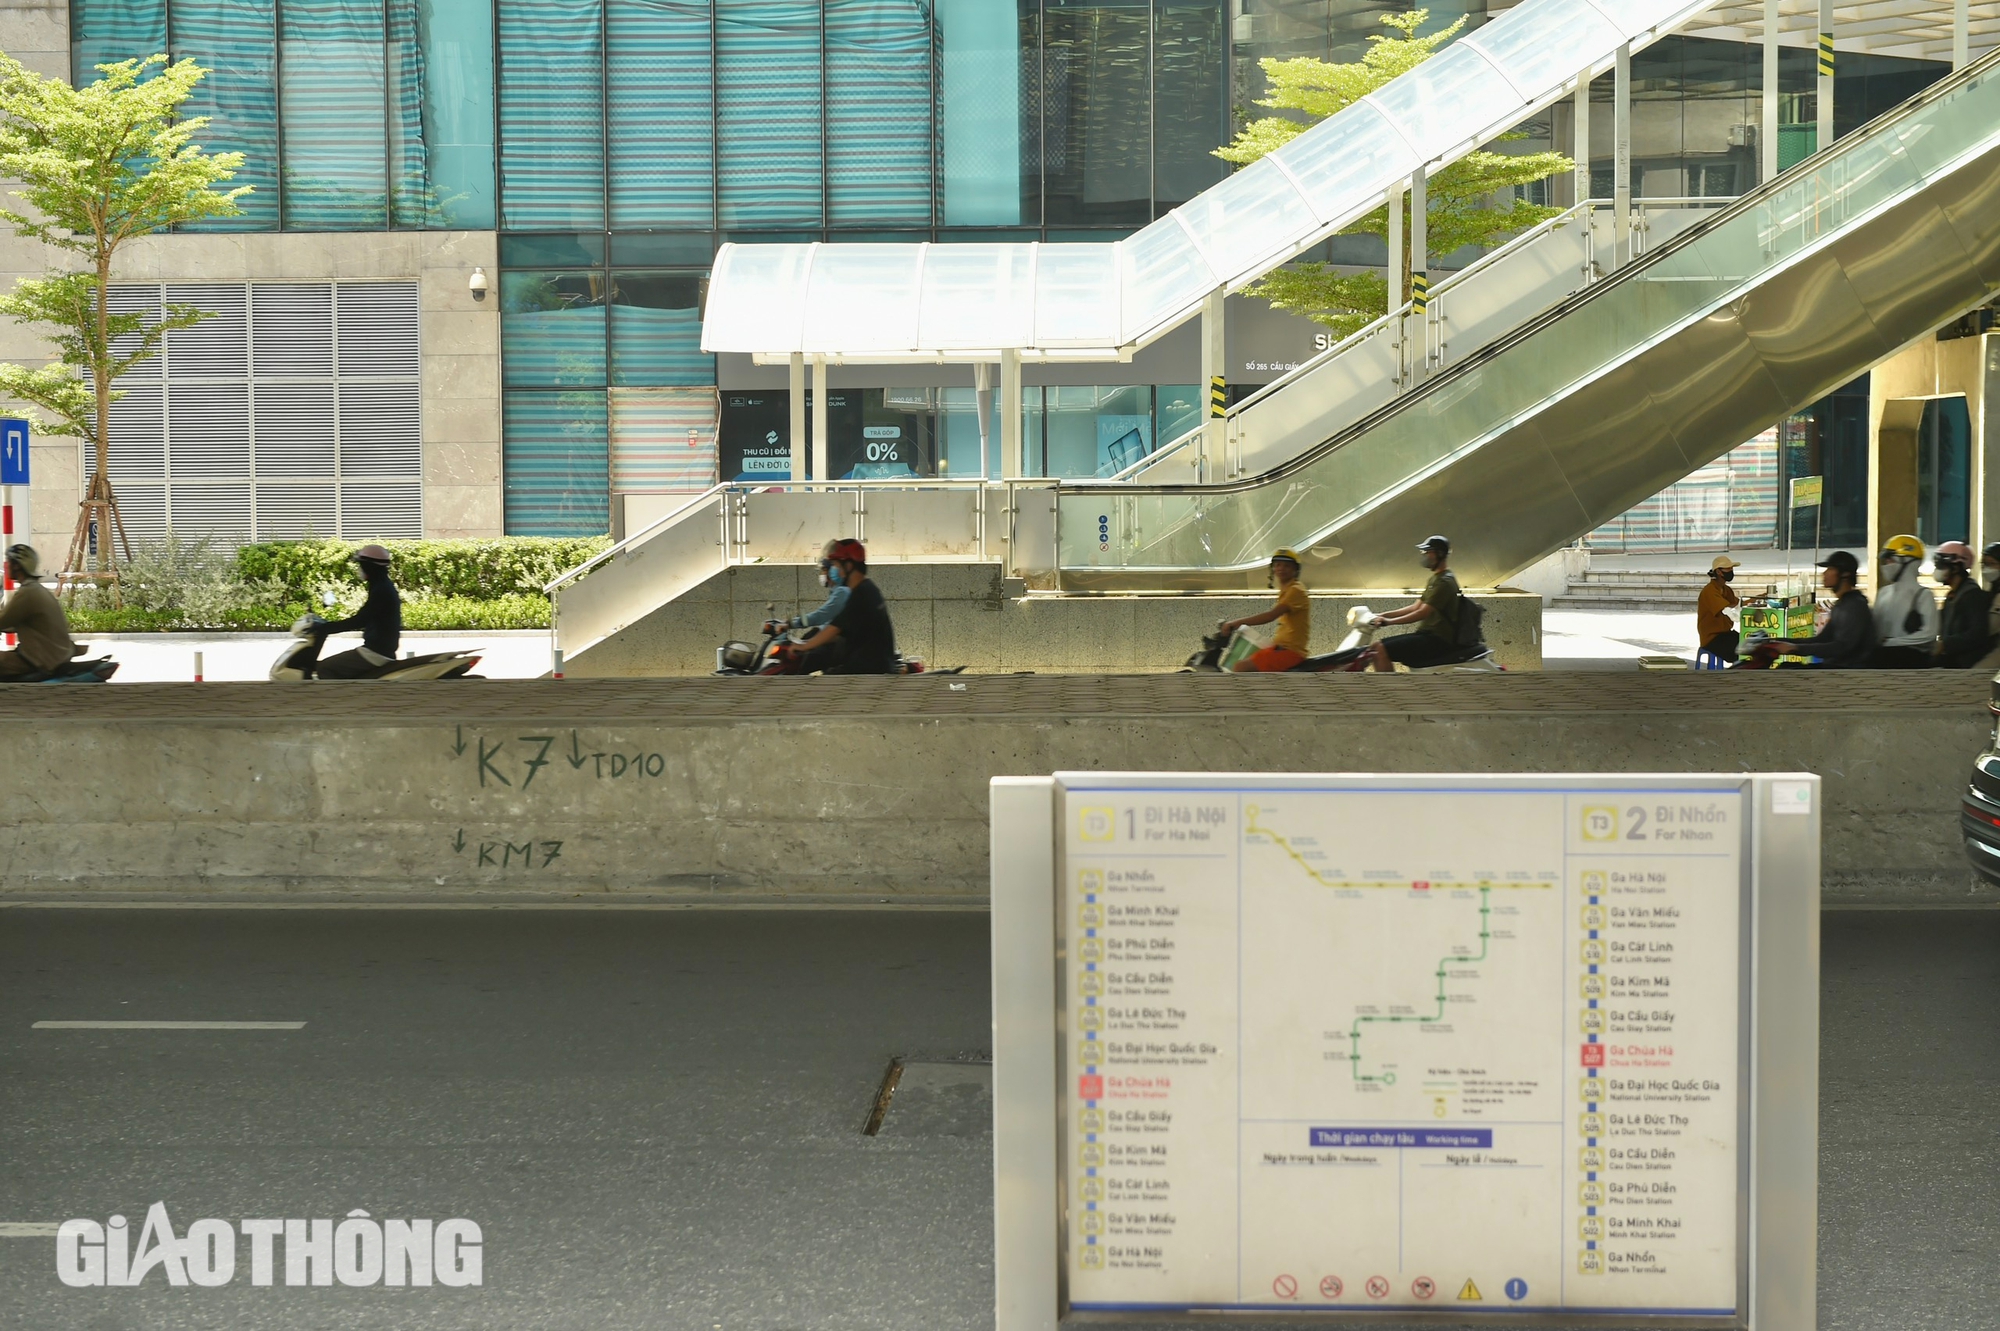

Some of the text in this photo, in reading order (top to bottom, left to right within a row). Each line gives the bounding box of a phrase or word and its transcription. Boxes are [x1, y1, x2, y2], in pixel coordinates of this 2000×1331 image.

[1246, 360, 1255, 370] SỐ
[743, 447, 788, 456] THU CŨ ĐỔI
[866, 442, 898, 461] 0%
[748, 460, 765, 469] LÊN
[767, 460, 782, 469] ĐỜI
[1144, 806, 1226, 828] Đi Hà Nội
[1655, 802, 1727, 823] Đi Nhổn
[1124, 808, 1136, 841] 1
[1590, 806, 1648, 841] T3 2
[1144, 829, 1211, 841] For Ha Noi
[1655, 829, 1714, 841] For Nhon
[1611, 872, 1666, 884] Ga Hà Nội
[1610, 941, 1674, 952] Ga Cát Linh
[1610, 976, 1624, 986] Ga
[1628, 976, 1650, 986] Kim
[1610, 1079, 1720, 1092] Ga Đại Học Quốc Gia
[1609, 1114, 1689, 1126] Ga Lê Đức Thọ
[1318, 1132, 1415, 1146] Thời gian chạy tàu
[1425, 1134, 1479, 1146] Working time
[1608, 1218, 1682, 1228] Ga Minh Khai
[1608, 1250, 1656, 1262] Ga Nhổn
